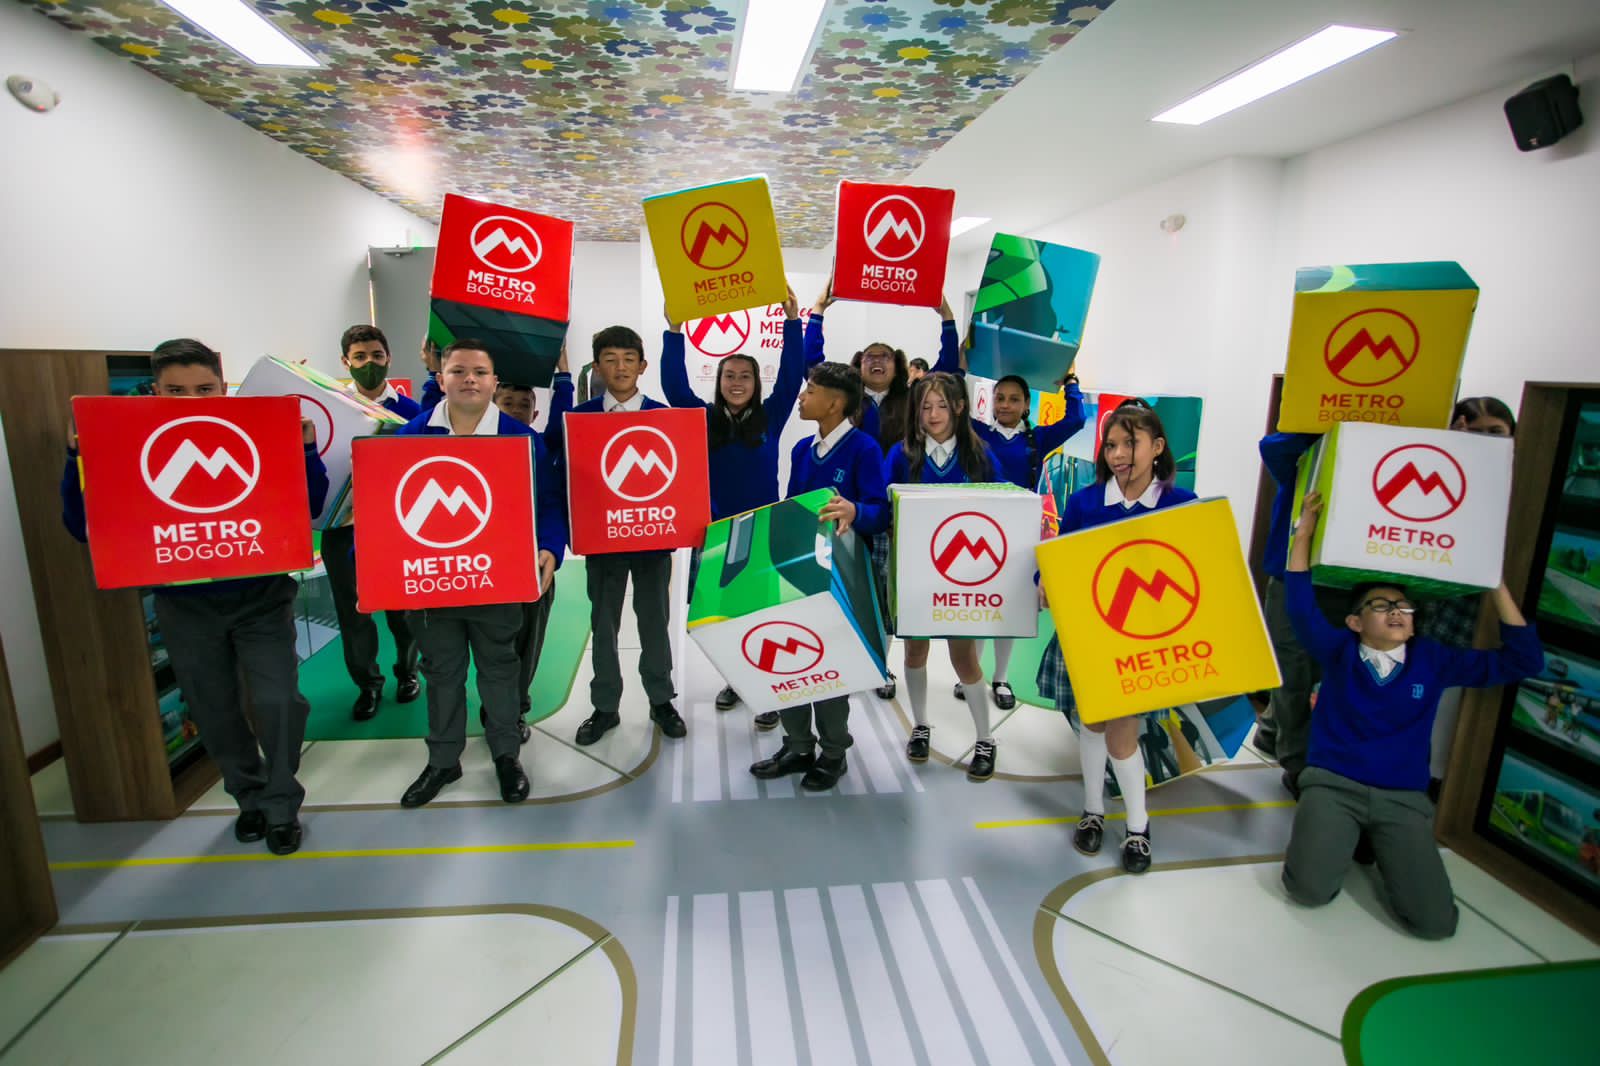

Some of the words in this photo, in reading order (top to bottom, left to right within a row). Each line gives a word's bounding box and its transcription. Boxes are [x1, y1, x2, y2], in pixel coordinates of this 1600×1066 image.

[467, 269, 536, 293] METRO
[694, 271, 754, 294] METRO
[862, 264, 918, 280] METRO
[466, 281, 535, 305] BOGOTÁ
[861, 277, 916, 293] BOGOTÁ
[1320, 394, 1404, 408] METRO
[606, 505, 676, 524] METRO
[153, 519, 262, 544] METRO
[607, 519, 677, 539] BOGOTÁ
[1368, 523, 1456, 550] METRO
[155, 538, 264, 564] BOGOTÁ
[1365, 541, 1453, 566] BOGOTÁ
[403, 553, 492, 576] METRO
[404, 569, 494, 595] BOGOTÁ
[932, 593, 1003, 608] METRO
[932, 606, 1003, 621] BOGOTÁ
[1115, 640, 1213, 676] METRO
[771, 670, 839, 692] METRO
[1121, 659, 1219, 695] BOGOTÁ
